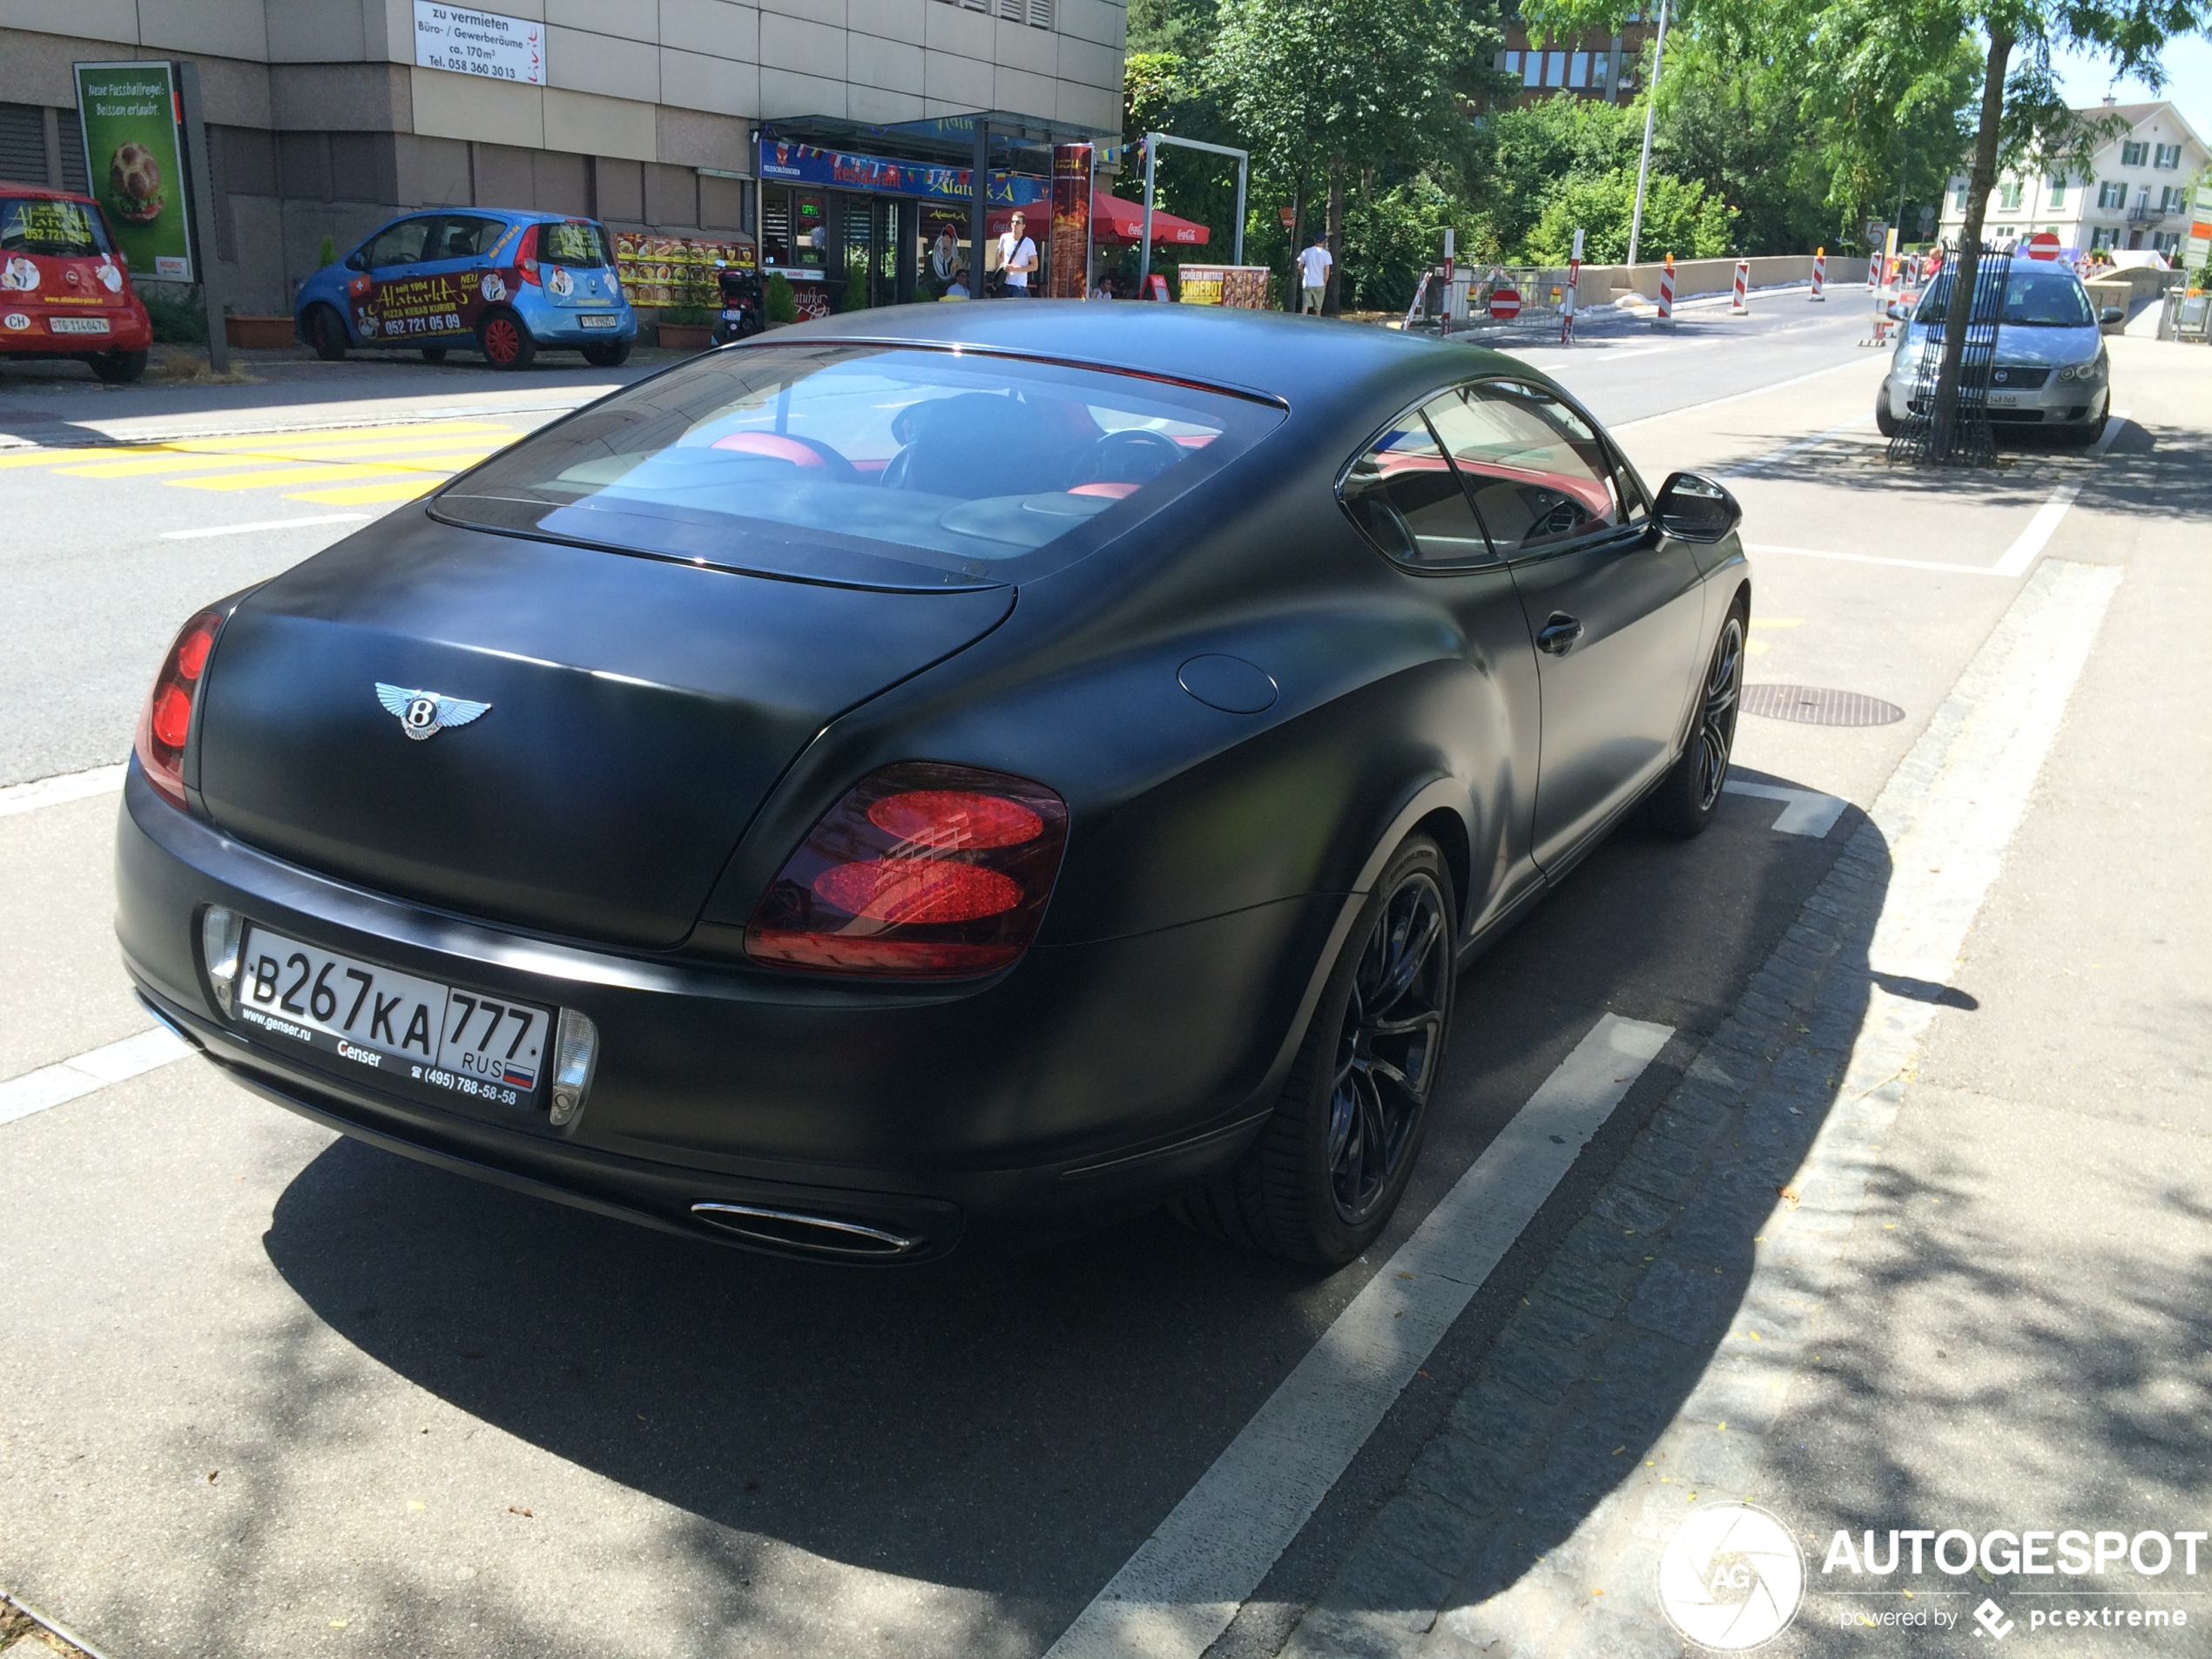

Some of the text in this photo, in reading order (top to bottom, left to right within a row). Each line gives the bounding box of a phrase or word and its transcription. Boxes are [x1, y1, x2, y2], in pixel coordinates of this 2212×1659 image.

[433, 9, 509, 30] zu vermieten
[418, 21, 443, 34] Büro-
[454, 27, 523, 49] Gewerberäume
[449, 45, 463, 55] ca.
[429, 56, 446, 67] Tel.
[448, 58, 467, 71] 058
[470, 62, 488, 74] 360
[89, 82, 165, 98] Neue Fussballregel:
[96, 101, 160, 116] Beissen erlaubt.
[764, 165, 801, 176] FELDSCHLÖSSCHEN
[802, 205, 819, 215] OPEN
[24, 228, 45, 240] 052
[46, 229, 64, 241] 721
[461, 273, 478, 284] NEU
[1180, 269, 1203, 280] SCHÜLER
[395, 281, 428, 293] seit 1994
[1180, 280, 1224, 297] ANGEBOT
[383, 302, 457, 319] PIZZA KEBAB KURIER
[9, 315, 25, 327] CH
[57, 320, 69, 330] TG
[385, 314, 461, 334] 052 721 05 09
[408, 699, 433, 726] B
[242, 1008, 312, 1042] www.genser.ru
[449, 993, 534, 1060] 777
[337, 1040, 382, 1068] Genser
[462, 1052, 502, 1078] RUS
[424, 1068, 517, 1106] (495) 788-58-58
